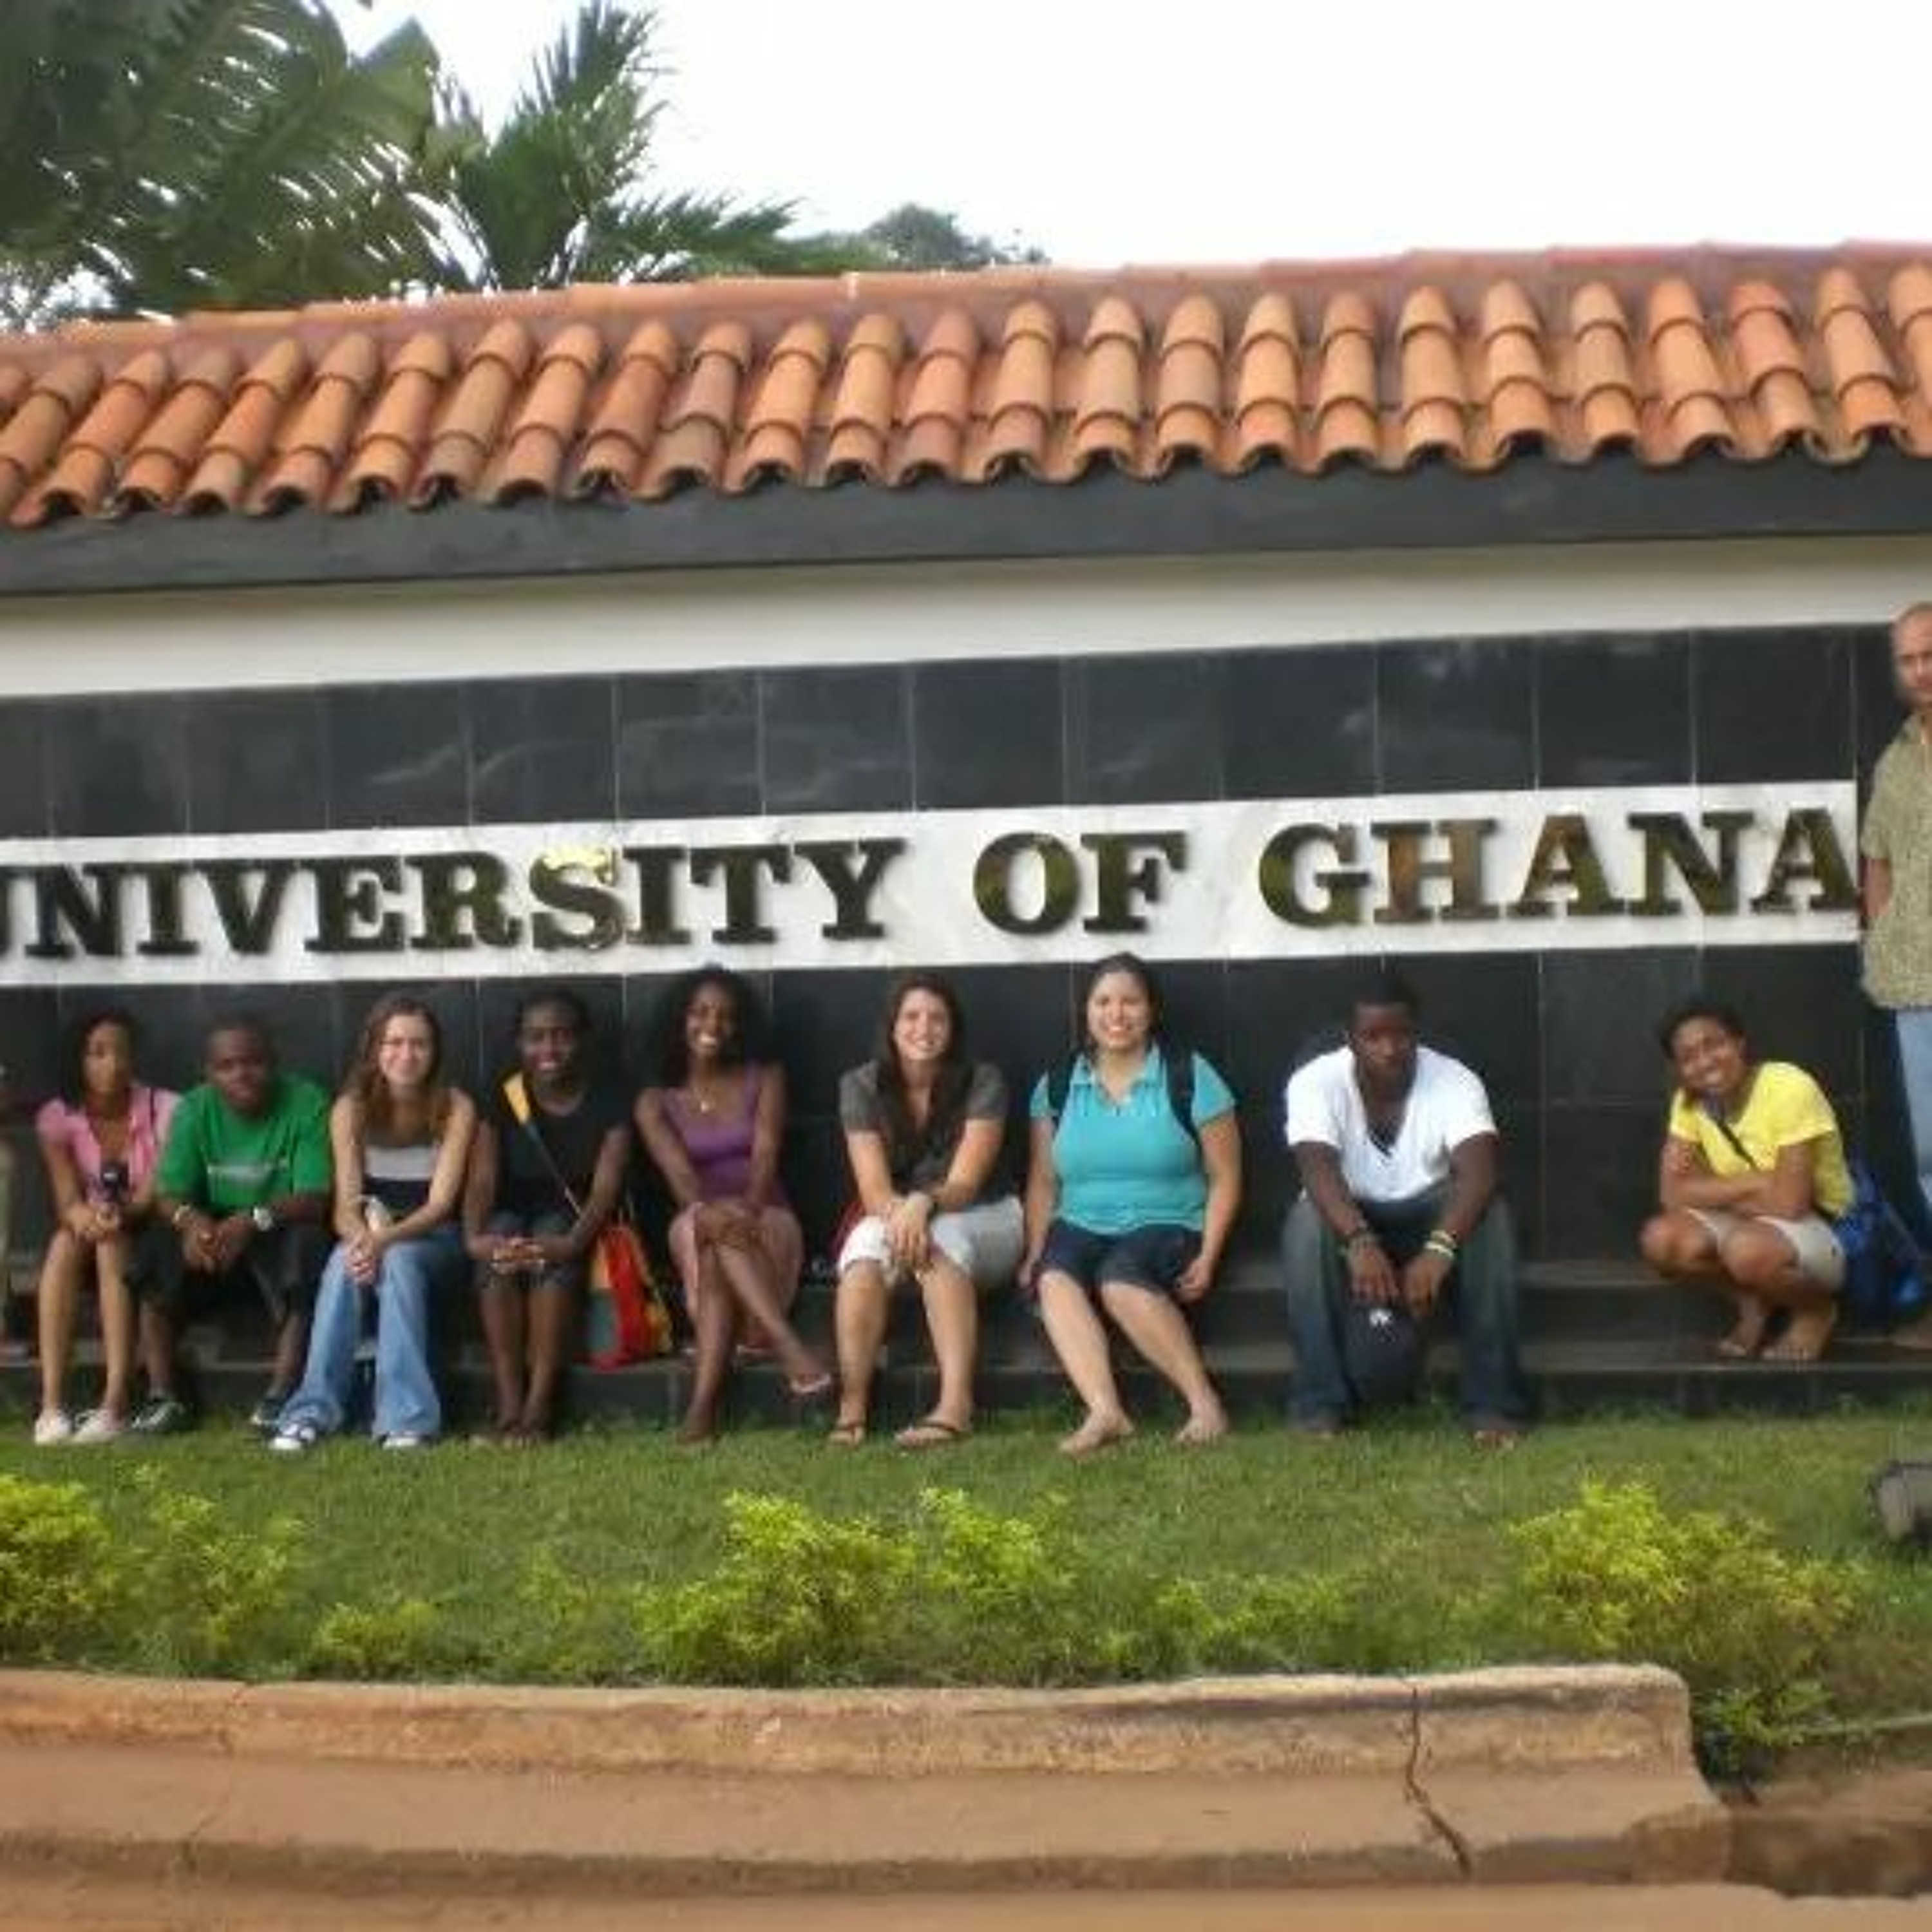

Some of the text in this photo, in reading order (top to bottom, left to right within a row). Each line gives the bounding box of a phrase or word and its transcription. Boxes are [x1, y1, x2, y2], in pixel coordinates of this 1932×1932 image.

[0, 807, 1859, 958] NIVERSITY OF GHANA
